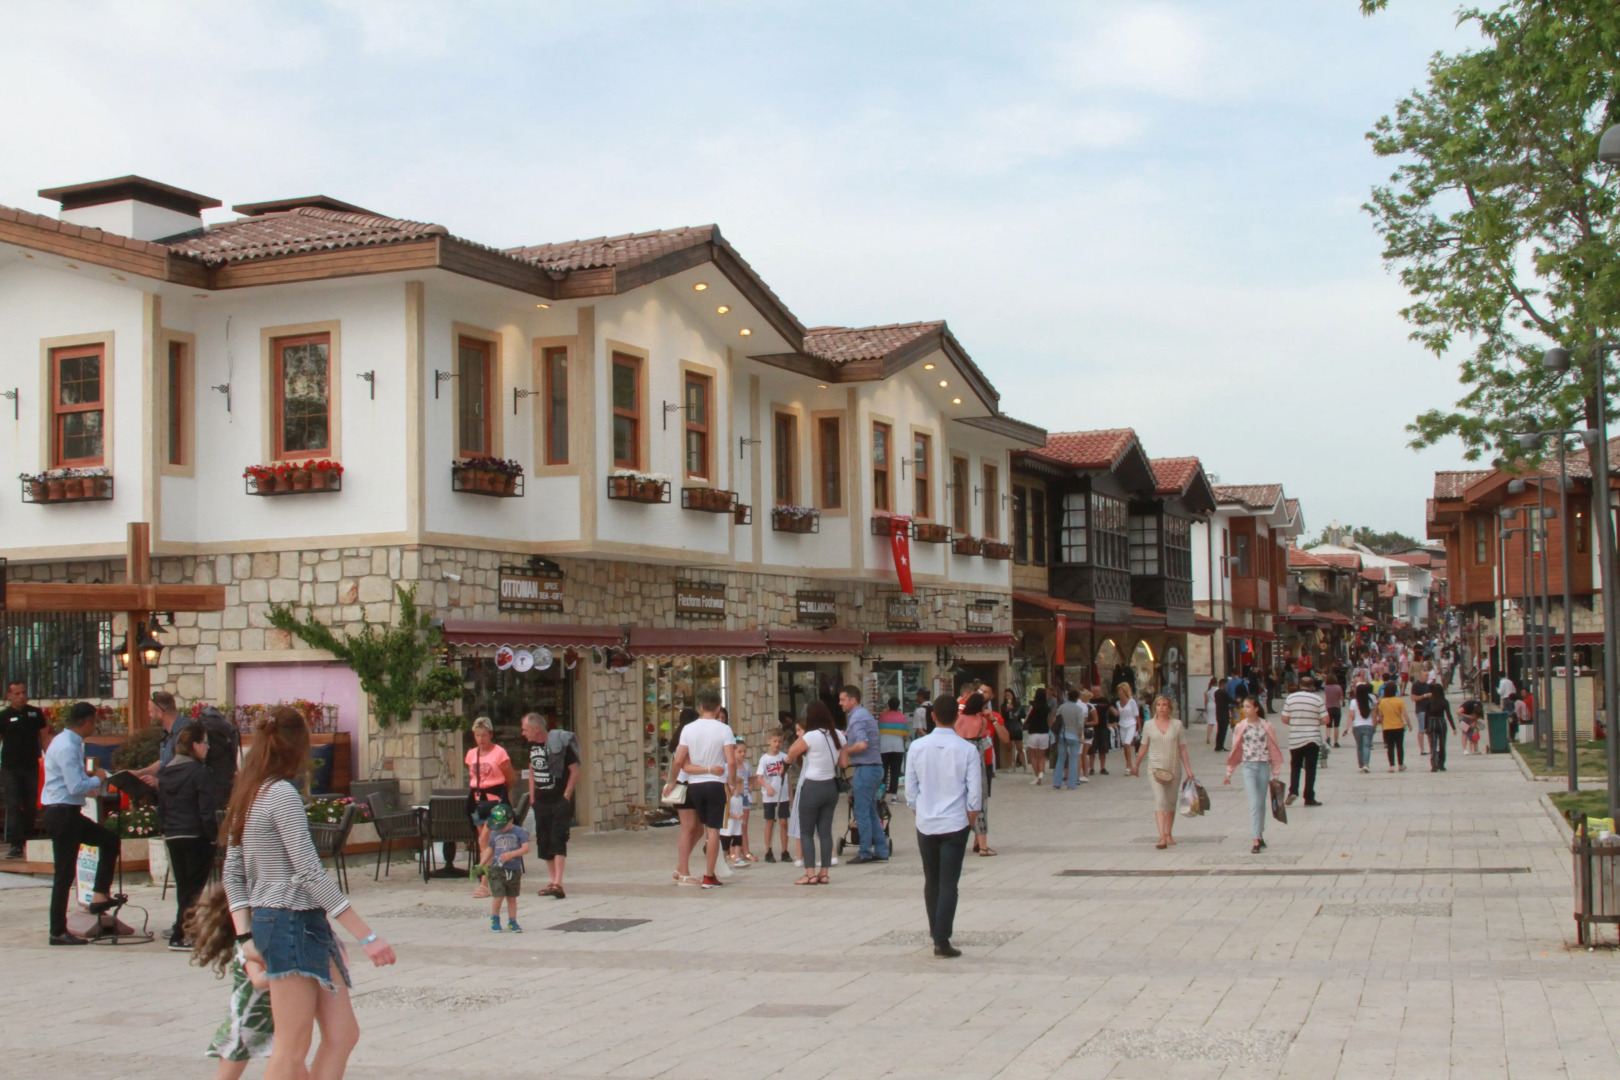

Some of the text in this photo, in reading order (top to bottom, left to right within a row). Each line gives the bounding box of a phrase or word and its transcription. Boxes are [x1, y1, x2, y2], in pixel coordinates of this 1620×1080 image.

[501, 579, 538, 599] OTTOMAN
[678, 593, 724, 609] Flexform Footwear
[807, 601, 835, 613] BILLABONG
